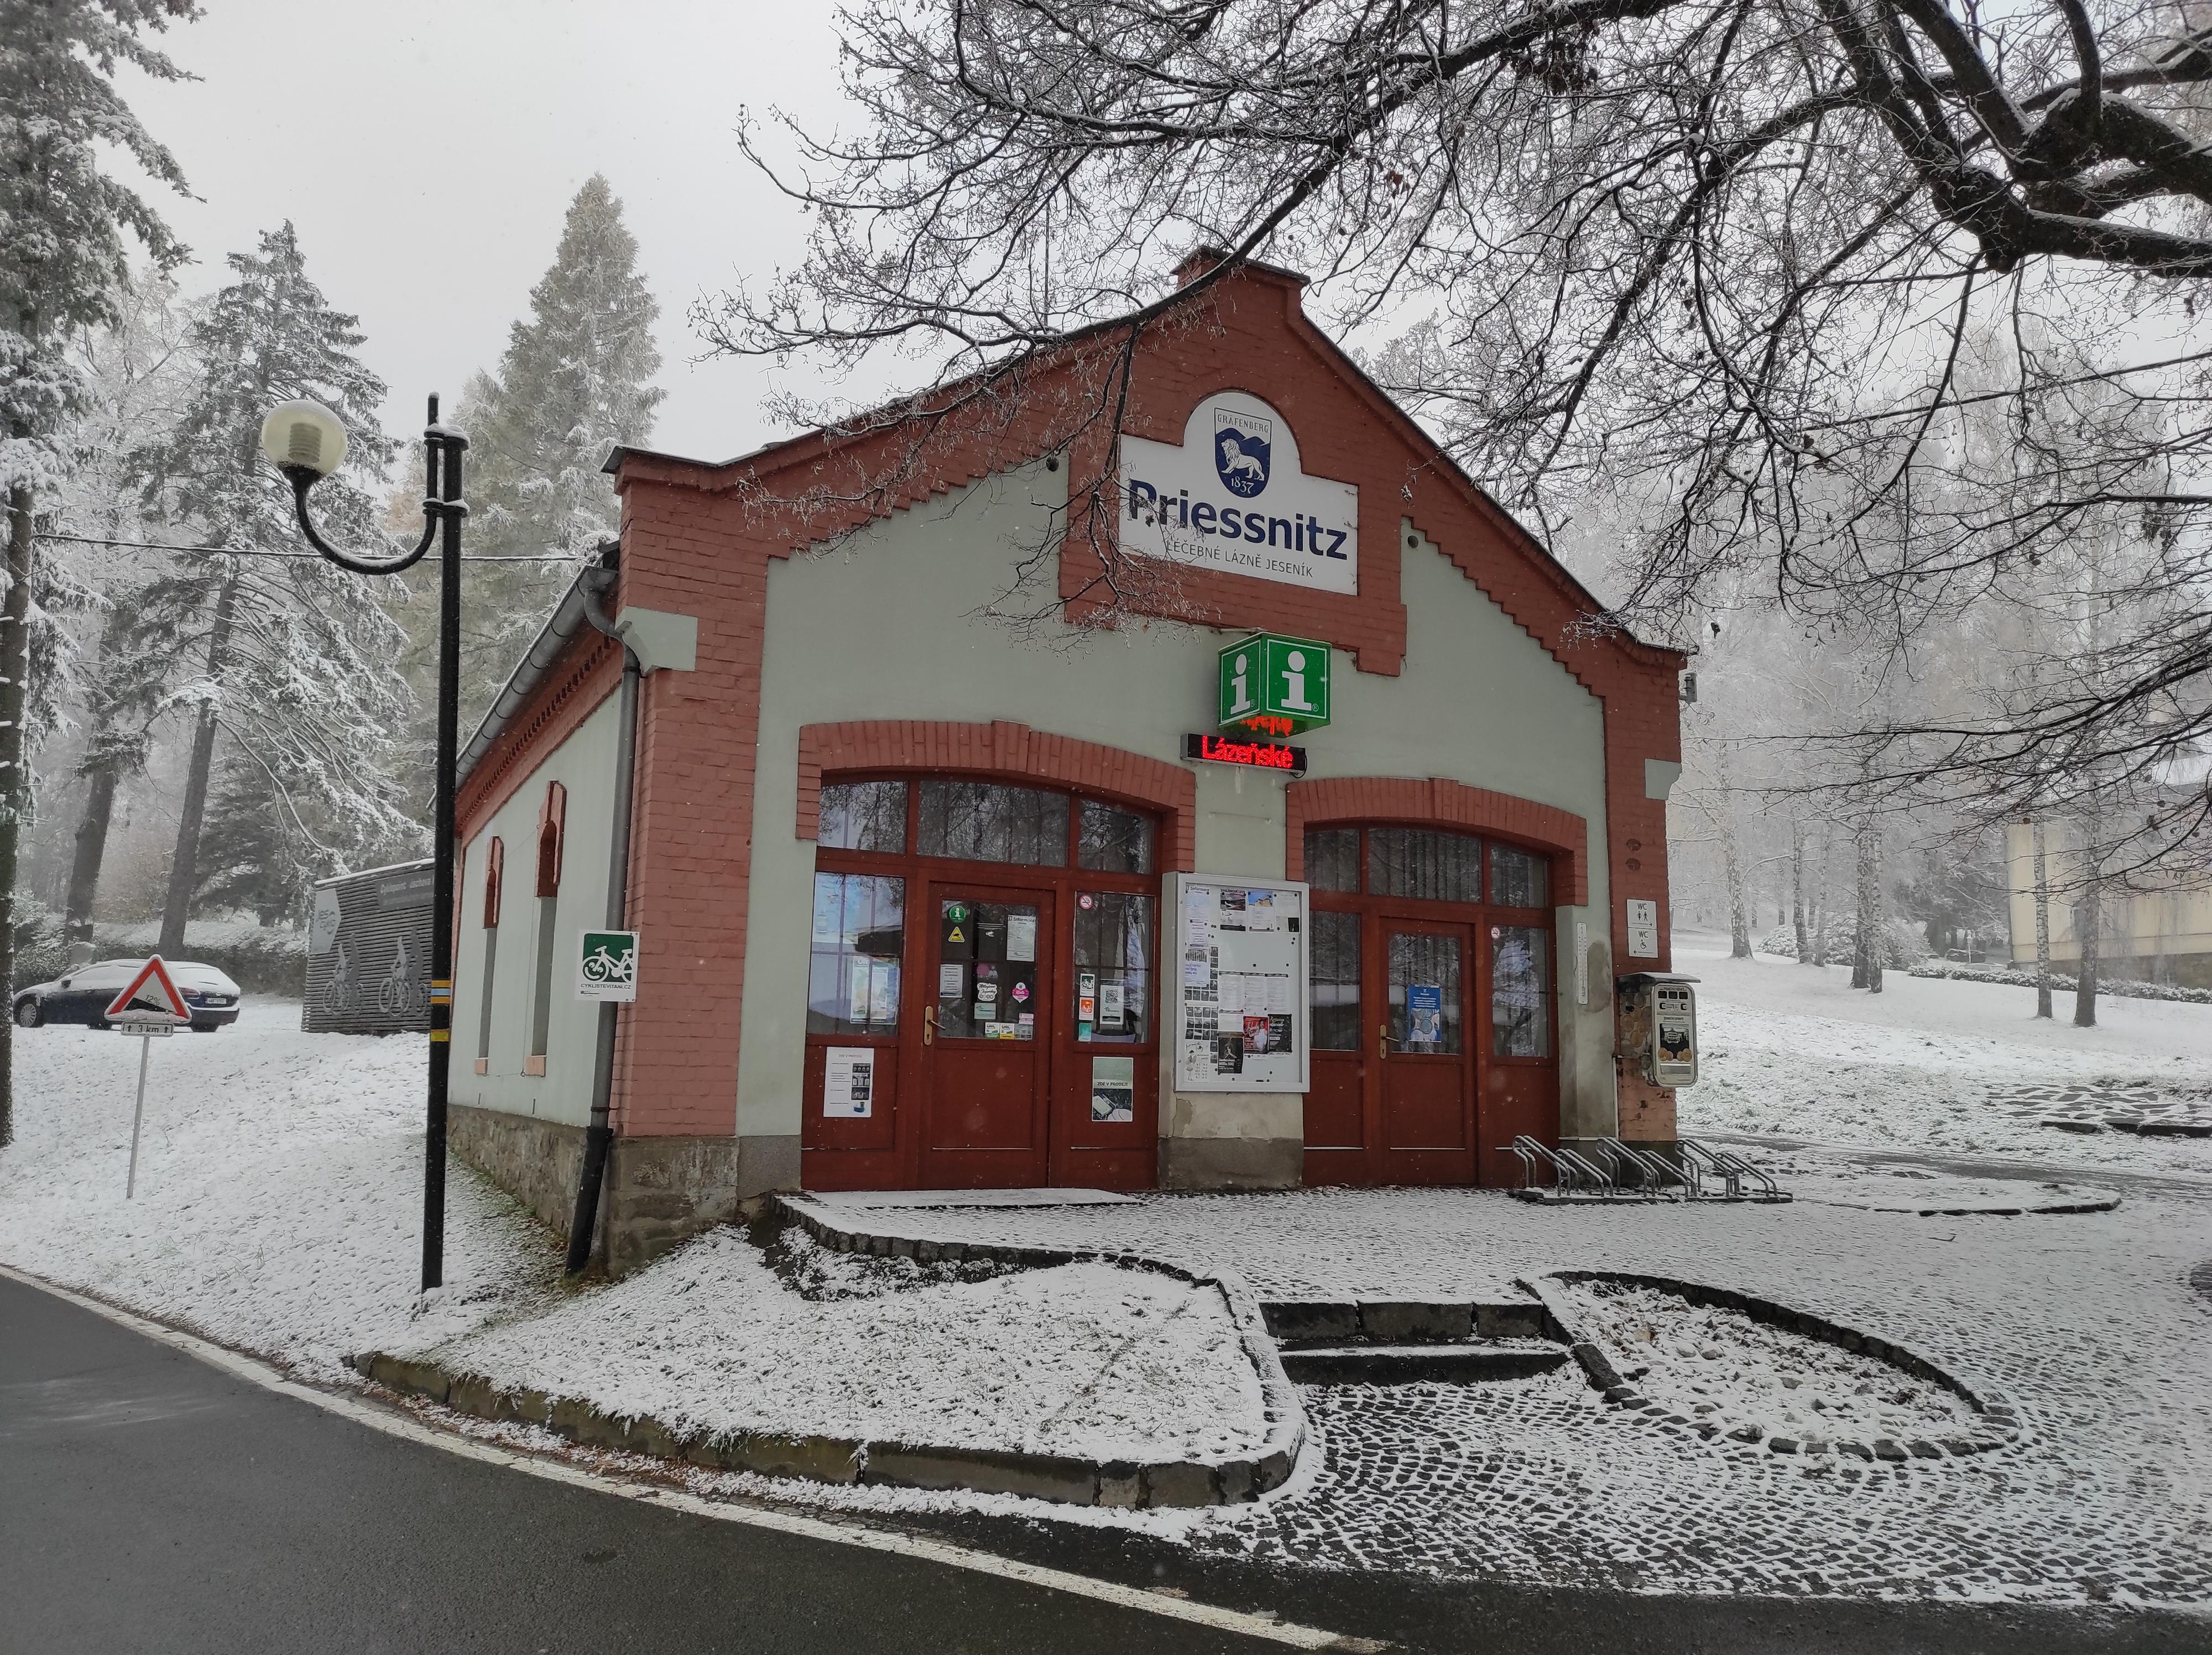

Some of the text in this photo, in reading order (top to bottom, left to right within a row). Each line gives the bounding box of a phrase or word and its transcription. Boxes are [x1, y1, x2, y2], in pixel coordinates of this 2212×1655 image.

[1217, 413, 1269, 434] GRÄFENBERG
[1230, 476, 1254, 494] 1837
[1129, 479, 1347, 560] Priessnitz
[1167, 539, 1313, 578] LÉČEBNÉ LÁZNĚ JESENÍK
[1202, 735, 1293, 768] Lázeňské
[145, 995, 160, 1005] 12%
[138, 1025, 159, 1033] 3 km
